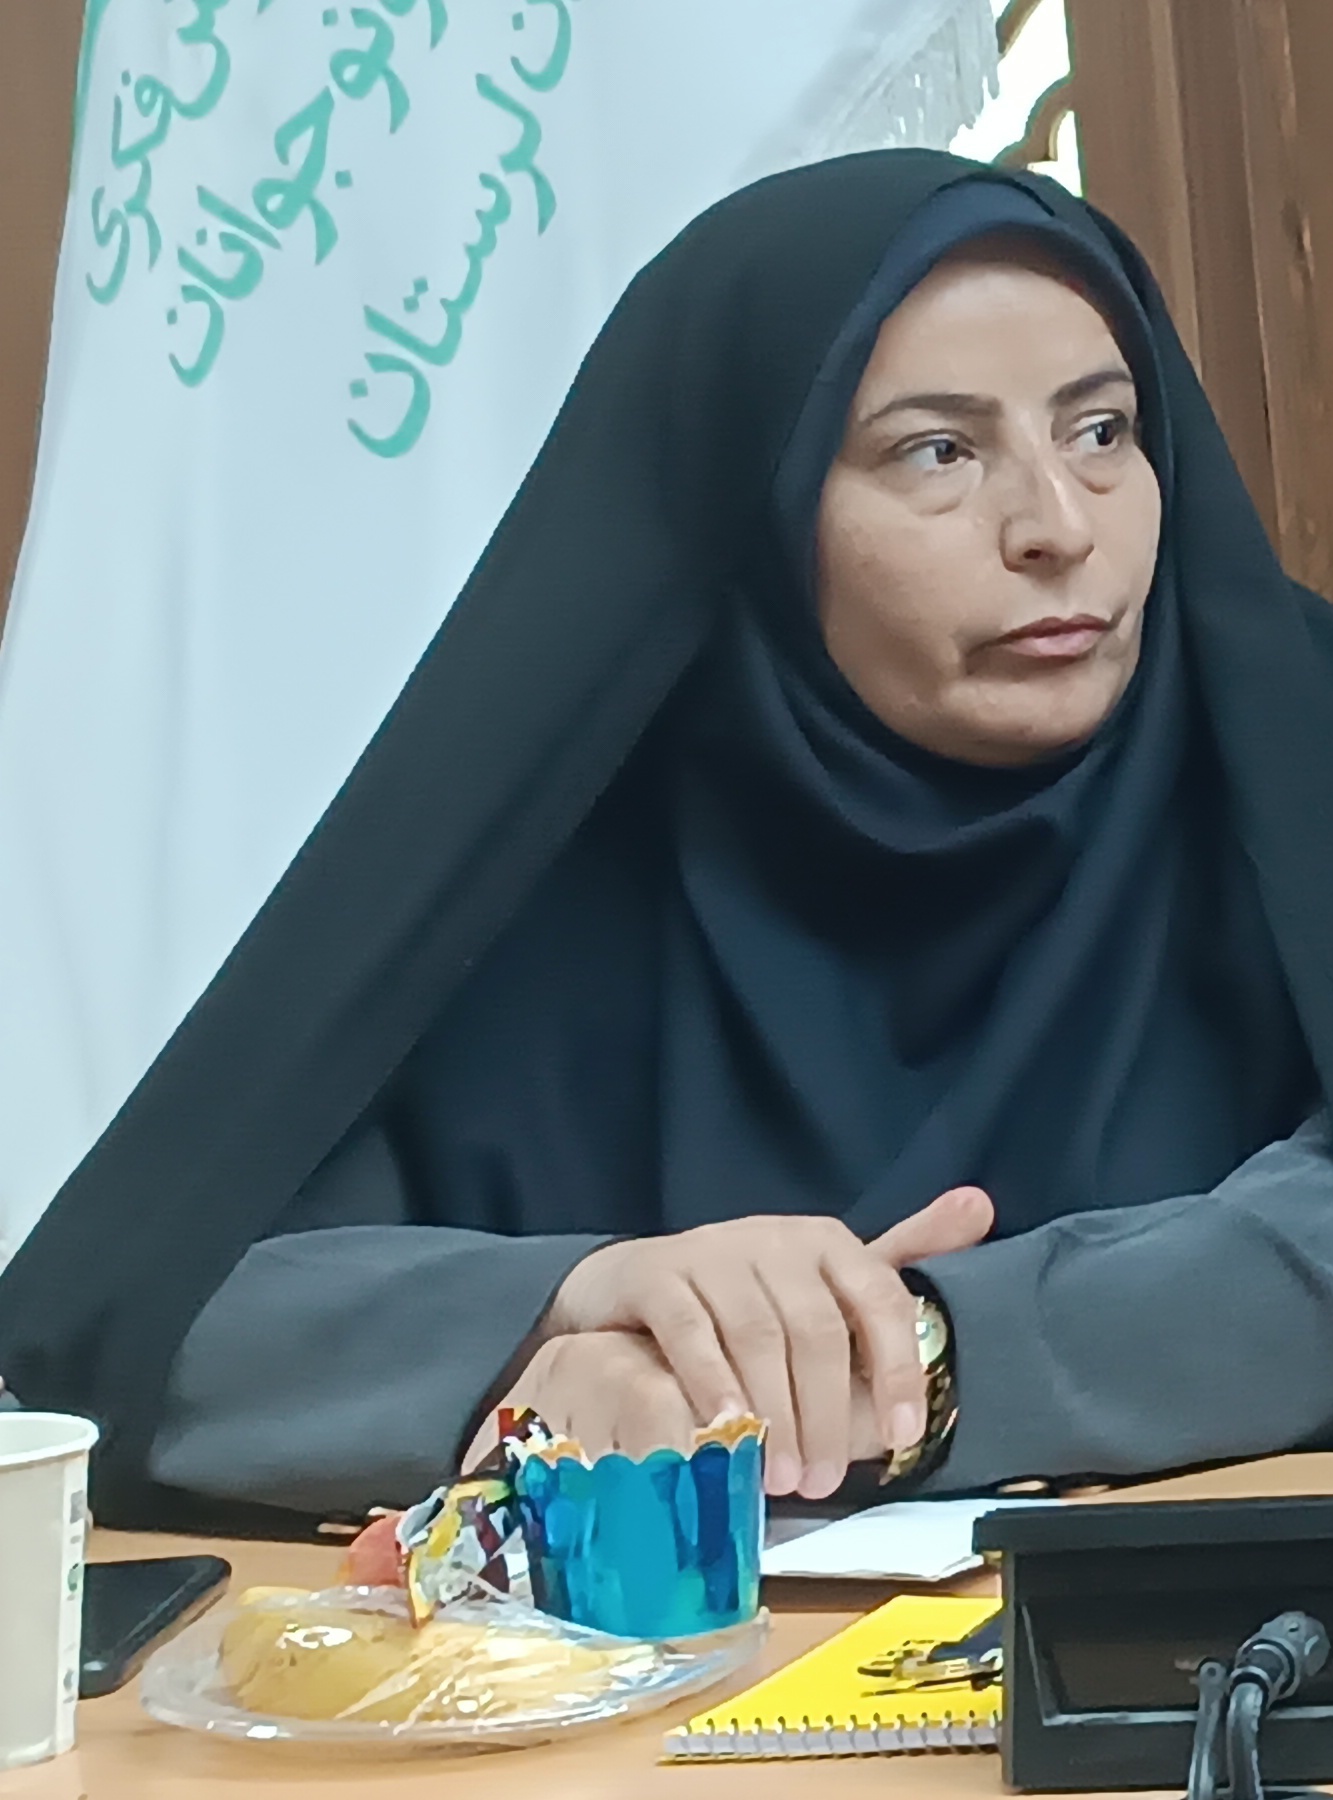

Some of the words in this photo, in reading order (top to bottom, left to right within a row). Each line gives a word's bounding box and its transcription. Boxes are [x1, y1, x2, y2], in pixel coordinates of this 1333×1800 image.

[86, 69, 172, 304] فکری
[167, 8, 411, 388] نوجوانان
[347, 73, 557, 459] لرستان
